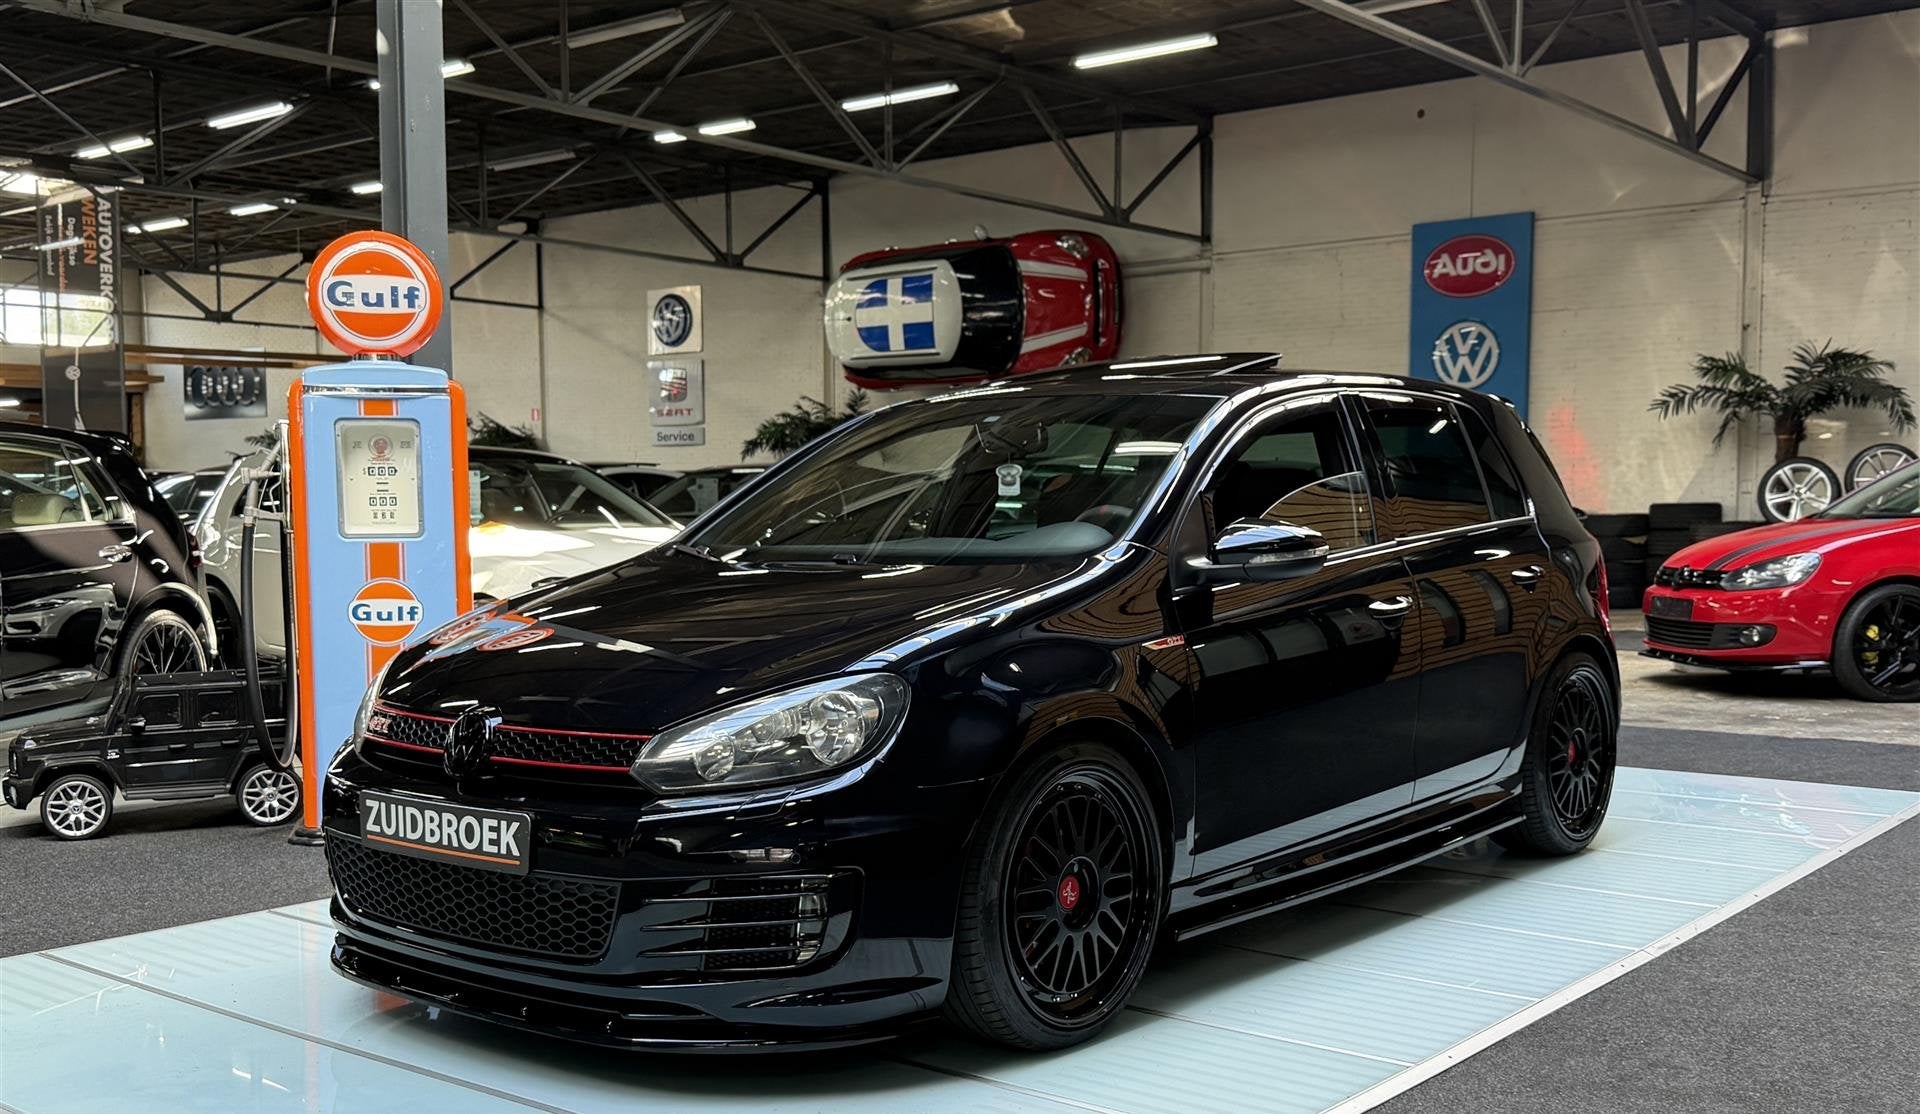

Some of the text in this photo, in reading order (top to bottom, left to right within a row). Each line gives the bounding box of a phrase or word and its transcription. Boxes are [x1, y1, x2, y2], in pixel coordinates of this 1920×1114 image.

[81, 197, 97, 265] WEKEN
[326, 280, 420, 309] Gulf
[656, 431, 695, 443] Service
[351, 603, 419, 621] Gulf
[365, 799, 521, 857] ZUIDBROEK
